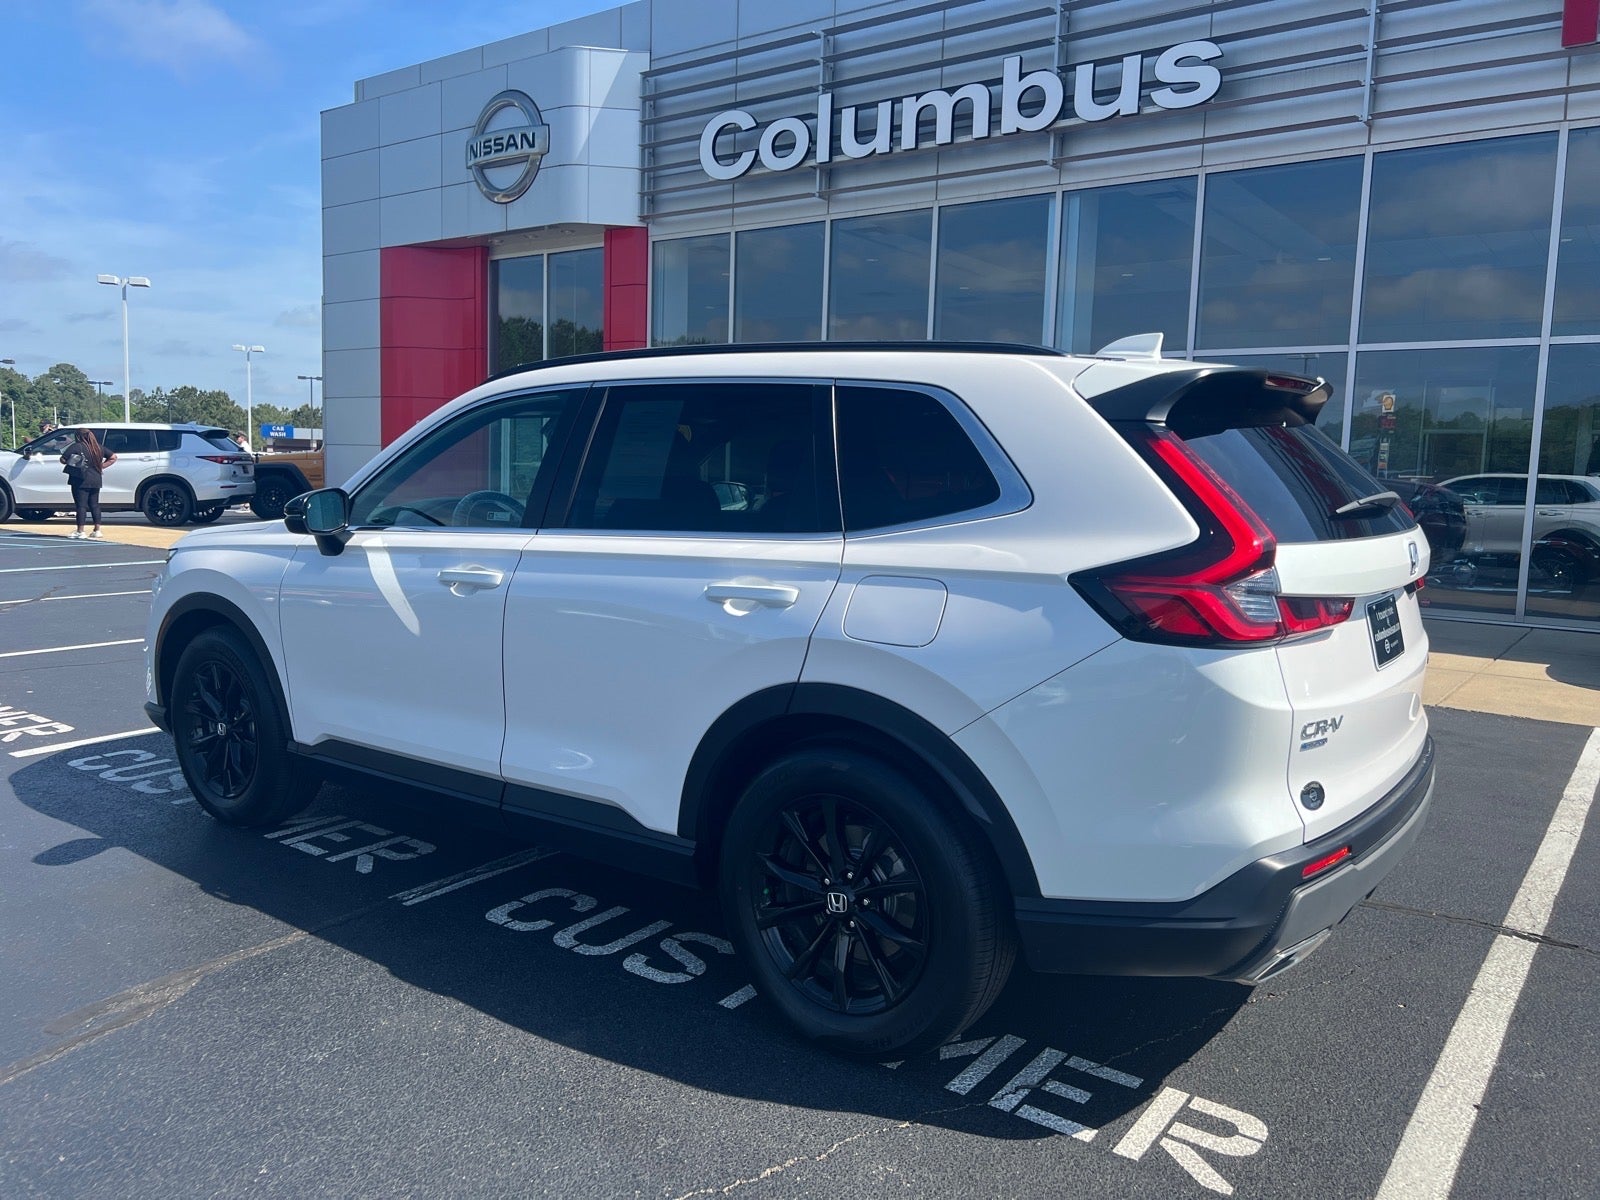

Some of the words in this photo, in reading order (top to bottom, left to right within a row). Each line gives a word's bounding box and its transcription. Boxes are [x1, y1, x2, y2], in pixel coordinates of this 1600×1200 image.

[700, 40, 1222, 180] Columbus
[469, 131, 536, 161] NISSAN
[1300, 714, 1344, 741] CR-V
